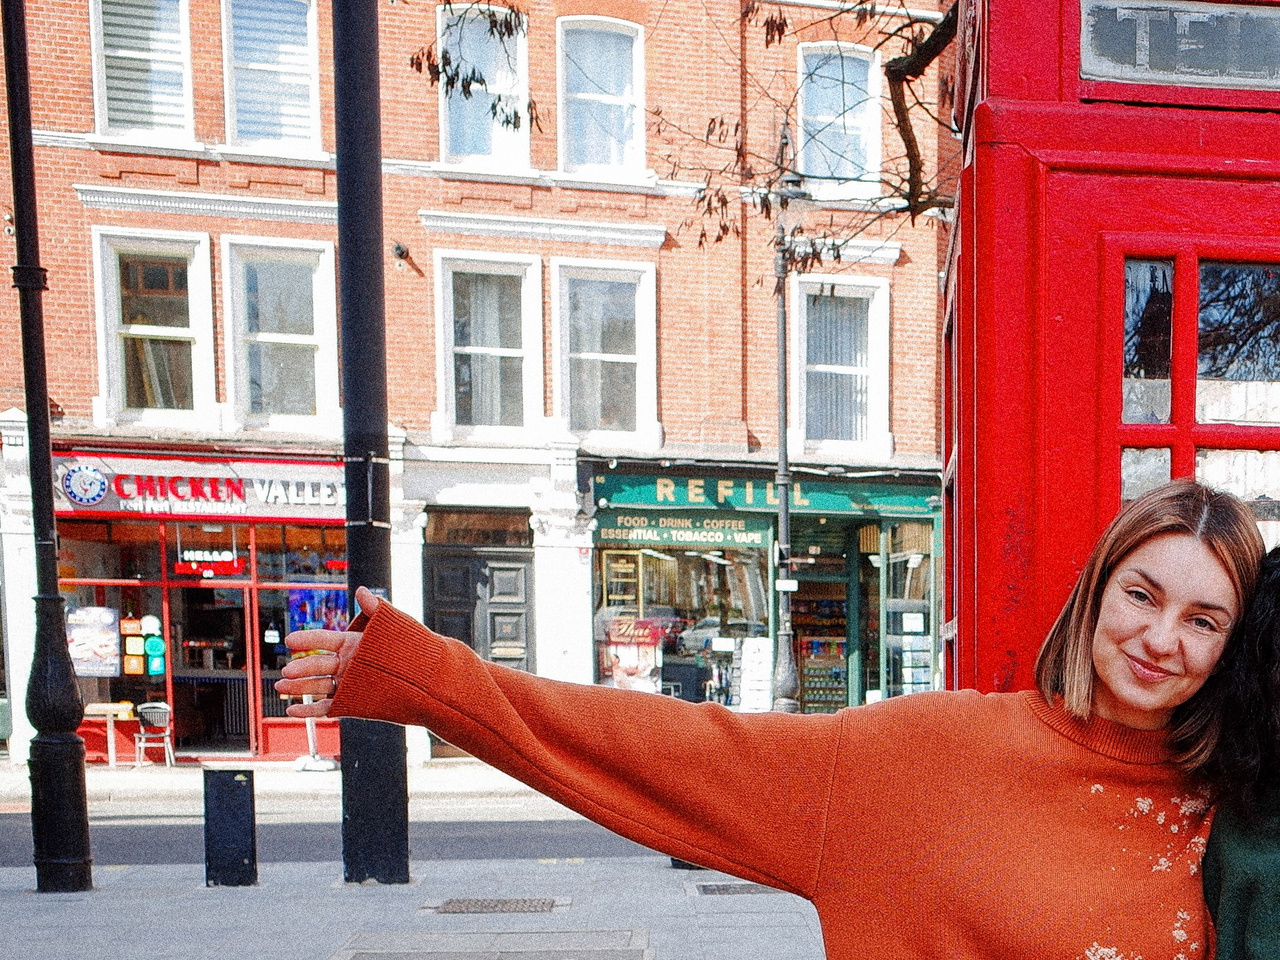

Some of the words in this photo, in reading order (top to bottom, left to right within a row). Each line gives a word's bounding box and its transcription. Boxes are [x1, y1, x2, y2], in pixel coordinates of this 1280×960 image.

[112, 473, 244, 501] CHICKEN
[252, 478, 346, 505] VALLE
[656, 477, 810, 507] REFILL
[617, 515, 648, 527] FOOD
[659, 517, 692, 529] DRINK
[703, 518, 745, 531] COFFEE
[601, 528, 660, 541] ESSENTIAL
[671, 530, 724, 542] TOBACCO
[734, 531, 762, 544] VAPE
[183, 550, 234, 562] HELLO
